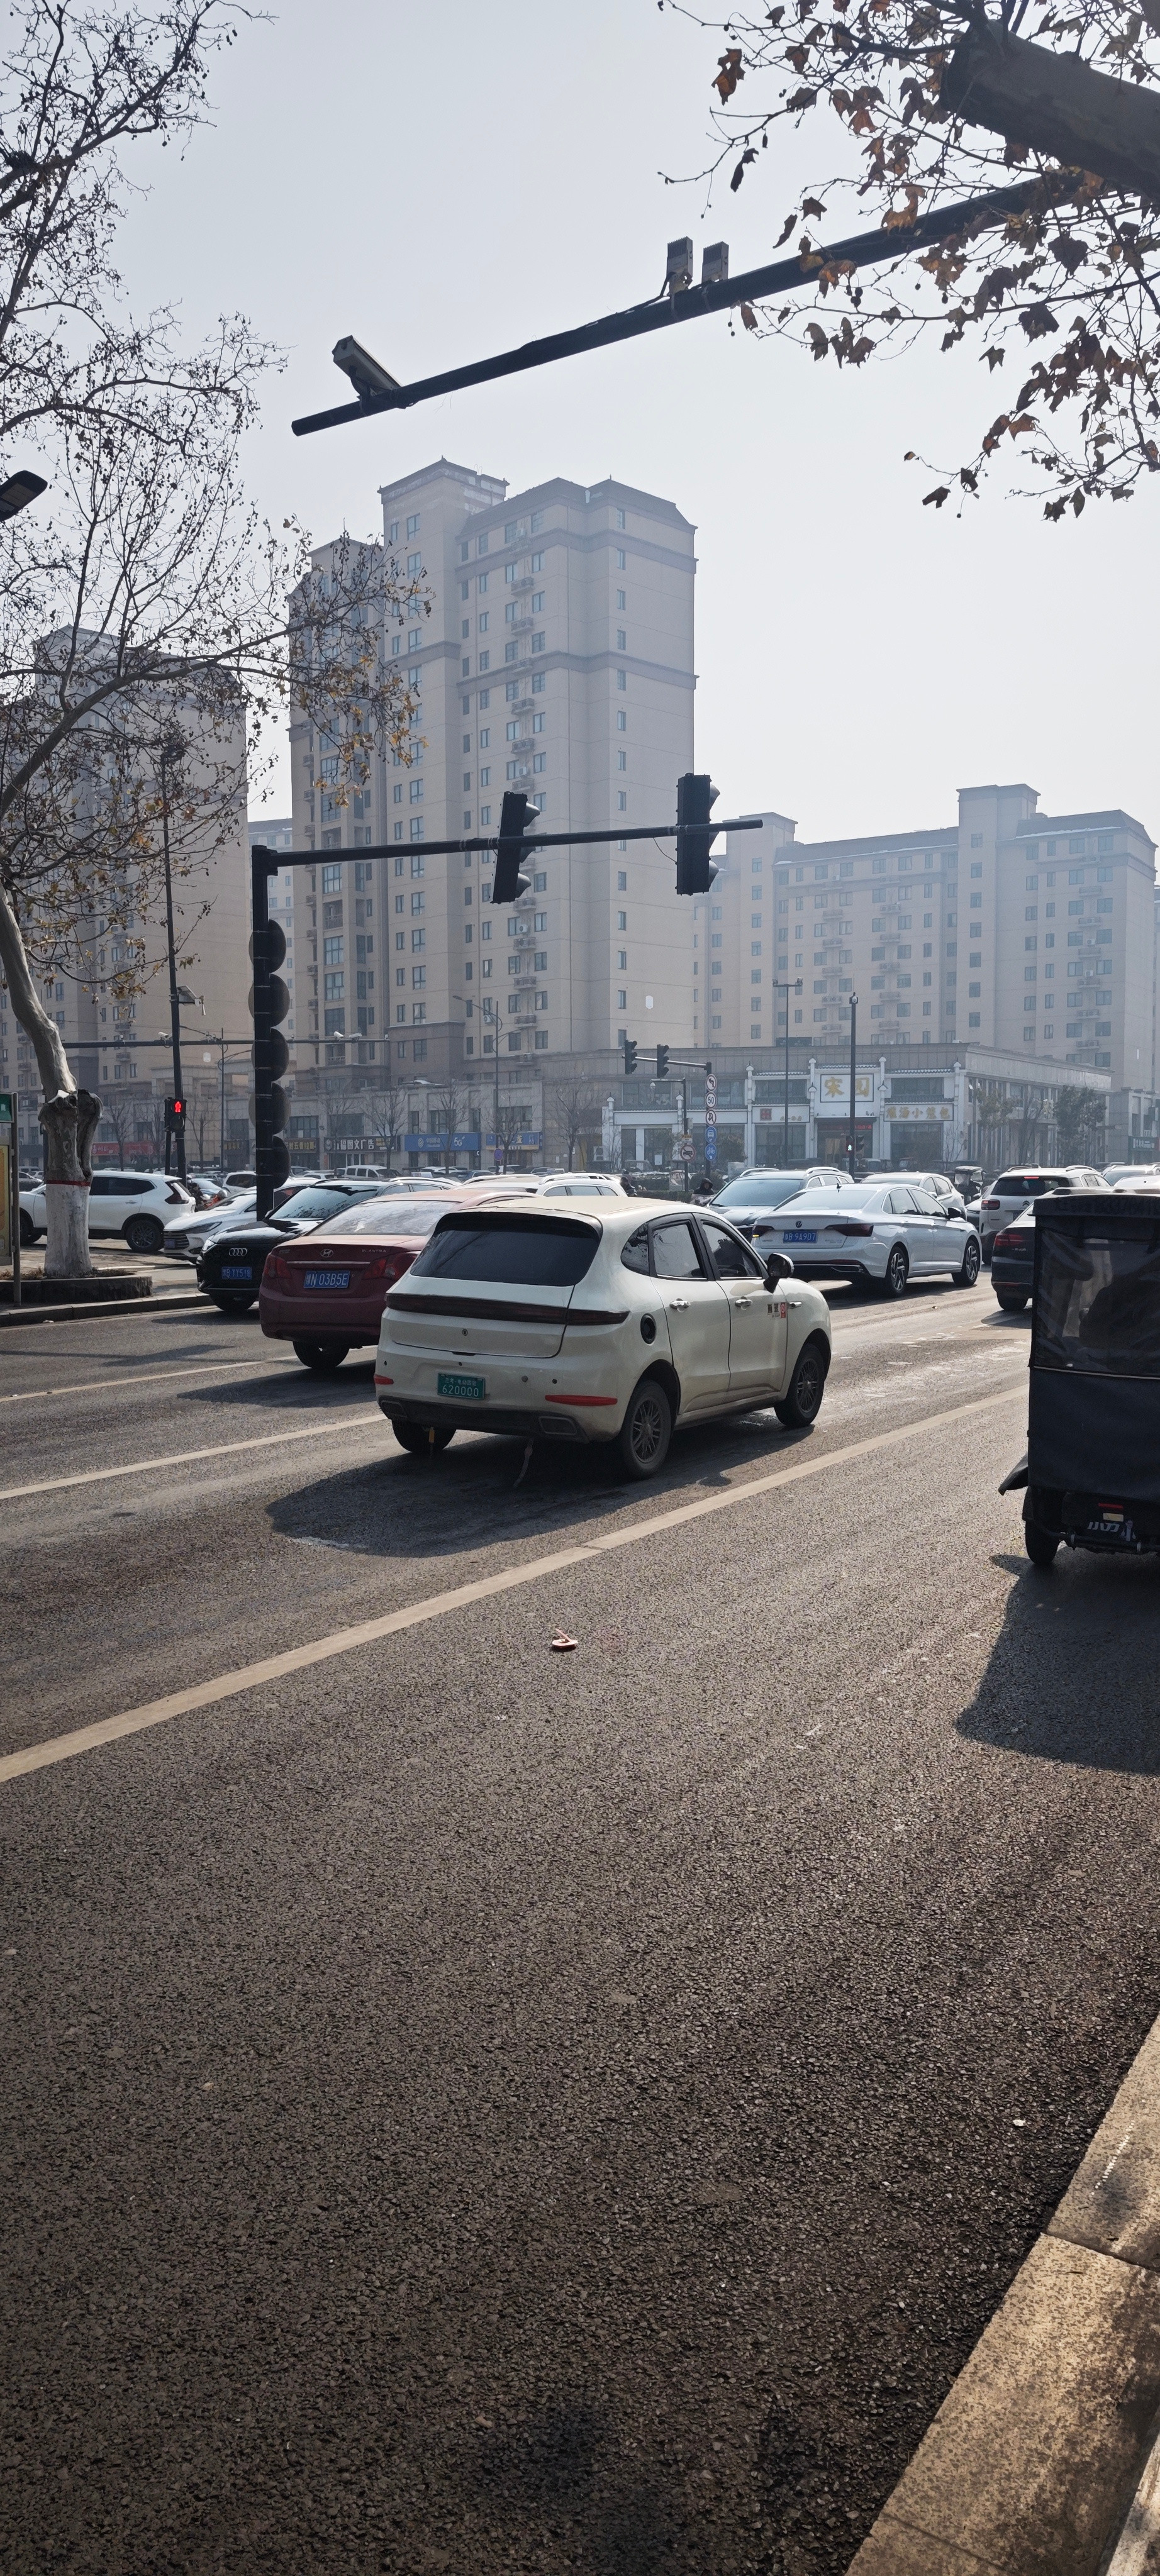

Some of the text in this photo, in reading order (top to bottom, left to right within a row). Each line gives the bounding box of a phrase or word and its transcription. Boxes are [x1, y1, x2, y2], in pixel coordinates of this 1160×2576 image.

[708, 1096, 715, 1104] 50
[454, 1138, 462, 1146] 5G
[442, 1385, 479, 1397] 620000
